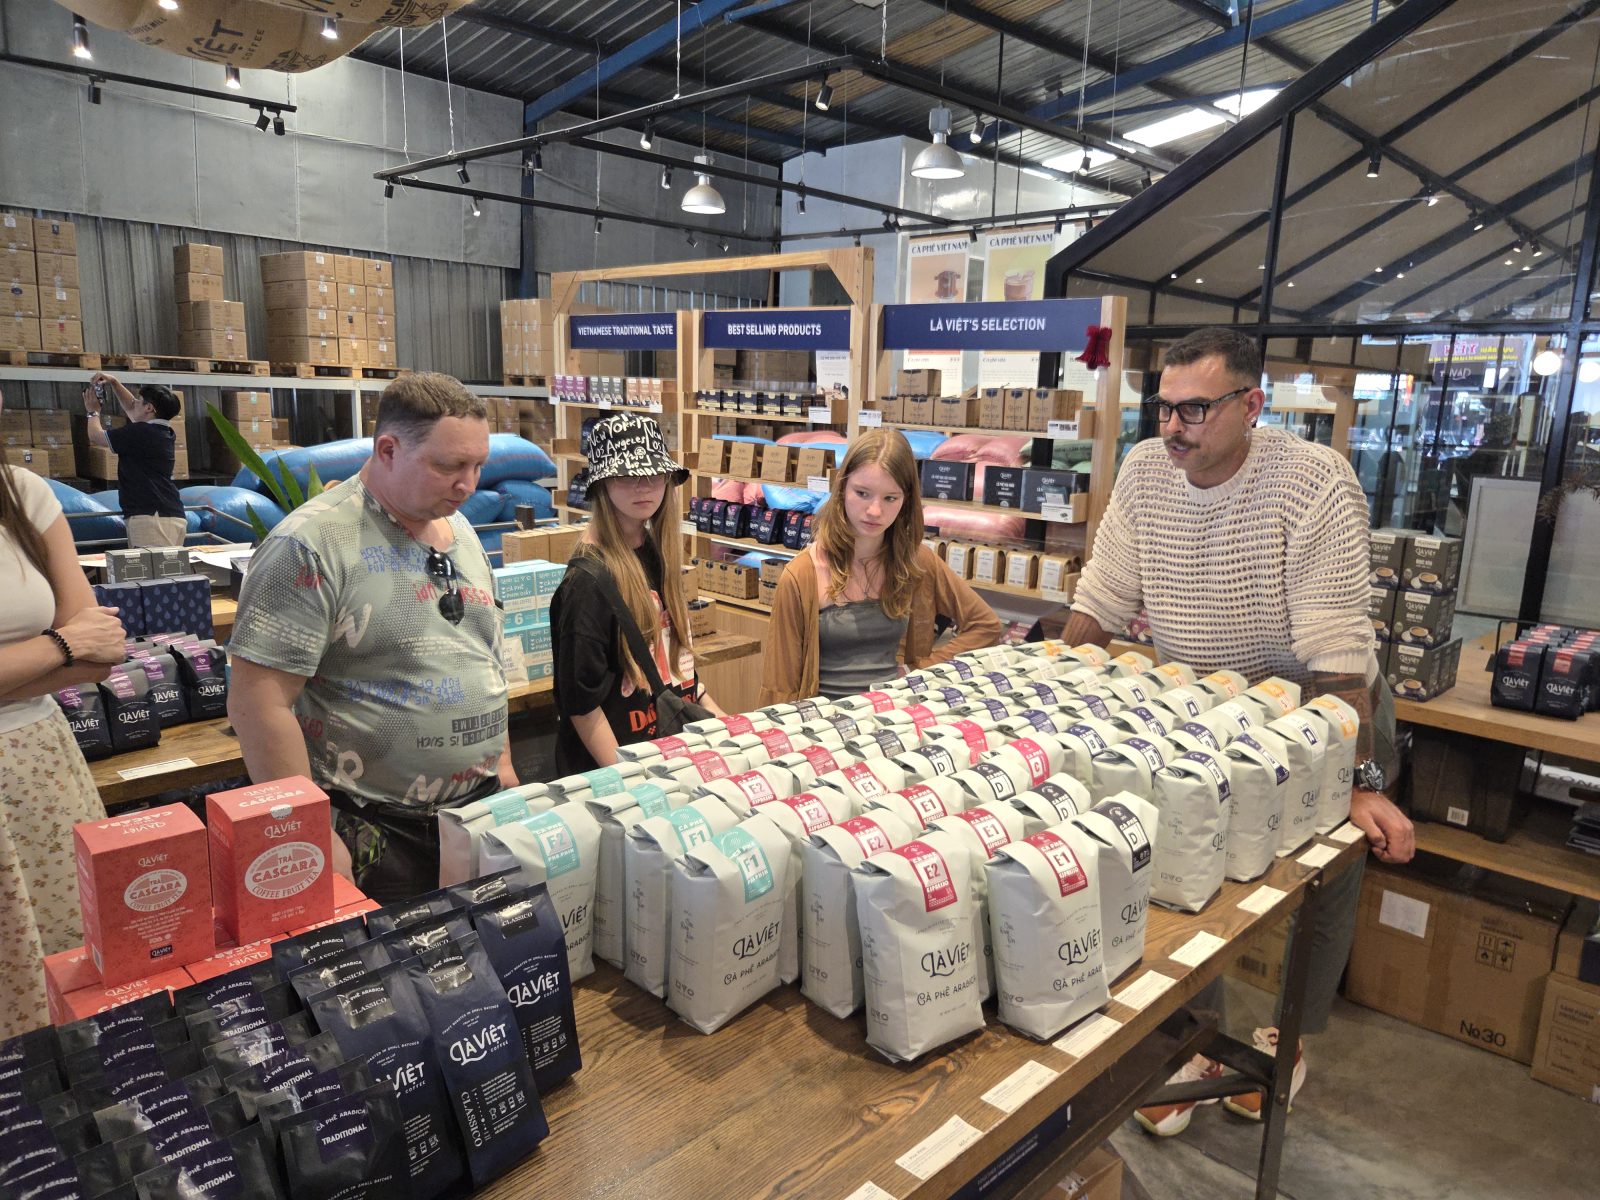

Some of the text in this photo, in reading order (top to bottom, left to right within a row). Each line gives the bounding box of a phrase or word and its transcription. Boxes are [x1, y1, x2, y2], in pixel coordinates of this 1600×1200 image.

[577, 324, 674, 336] VIETNAMESE TRADITIONAL TASTE
[727, 323, 822, 336] BEST SELLING PRODUCTS
[930, 317, 1046, 333] LÀ VIỆT'S SELECTION
[514, 613, 524, 625] 6
[543, 663, 552, 676] 6
[936, 762, 946, 774] D
[1033, 761, 1041, 773] C
[749, 781, 766, 795] E2
[860, 780, 877, 794] E1
[994, 781, 1004, 794] D
[238, 790, 305, 808] CASCARA
[921, 798, 938, 813] E1
[806, 805, 823, 820] E2
[1060, 806, 1069, 819] D
[688, 828, 706, 847] F1
[984, 823, 1001, 838] E1
[1128, 830, 1138, 846] D
[866, 835, 885, 850] E2
[743, 854, 760, 876] F1
[1053, 851, 1071, 867] E1
[252, 857, 318, 883] CASCARA
[923, 861, 941, 880] E2
[129, 880, 182, 900] CASCARA
[252, 870, 319, 899] COFFEE FRUIT TEA
[502, 911, 533, 926] CLASSICO
[321, 937, 344, 948] ARABICA
[338, 959, 363, 971] ARABICA
[443, 954, 464, 965] ARABICA
[434, 965, 467, 984] CLASSICO
[228, 981, 252, 991] ARABICA
[361, 986, 385, 997] ARABICA
[543, 987, 560, 998] COFFEE
[241, 1006, 265, 1016] ARABICA
[349, 996, 388, 1017] CLASSICO
[117, 1015, 144, 1026] ARABICA
[225, 1018, 267, 1037] TRADITIONAL
[127, 1042, 155, 1054] ARABICA
[490, 1040, 509, 1053] COFFEE
[272, 1066, 283, 1077] PHÊ
[284, 1056, 310, 1069] ARABICA
[136, 1070, 165, 1082] ARABICA
[270, 1069, 314, 1093] TRADITIONAL
[314, 1083, 341, 1096] ARABICA
[405, 1080, 426, 1095] COFFEE
[159, 1093, 188, 1107] ARABICA
[325, 1113, 338, 1125] PHÊ
[339, 1108, 366, 1120] ARABICA
[460, 1091, 484, 1148] CLASSICO
[11, 1119, 43, 1132] ARABICA
[165, 1131, 179, 1144] PHÊ
[180, 1123, 210, 1136] ARABICA
[321, 1123, 368, 1146] TRADITIONAL
[24, 1146, 57, 1160] ARABICA
[162, 1137, 212, 1165] TRADITIONAL
[203, 1154, 233, 1169] ARABICA
[44, 1175, 78, 1189] ARABICA
[185, 1169, 236, 1198] TRADITIONAL
